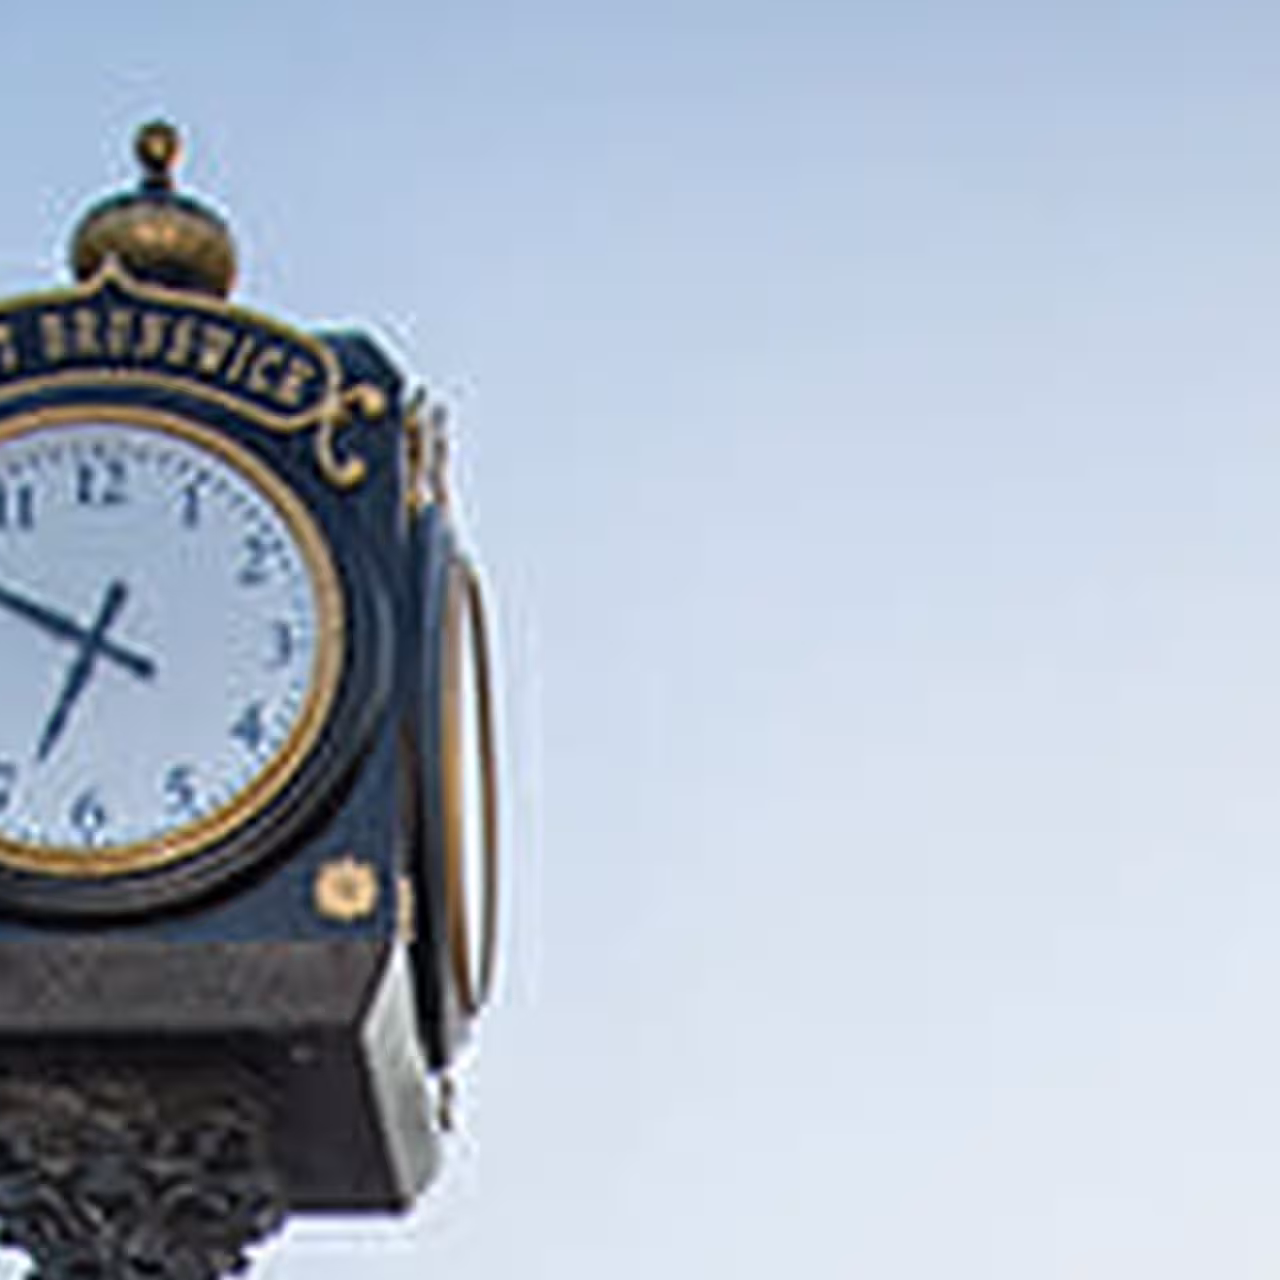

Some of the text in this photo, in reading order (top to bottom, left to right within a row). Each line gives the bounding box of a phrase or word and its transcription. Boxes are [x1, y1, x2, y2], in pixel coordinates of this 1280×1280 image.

[76, 463, 125, 504] 12
[182, 484, 201, 529] 1
[237, 534, 269, 585] 2
[265, 622, 294, 667] 3
[231, 703, 265, 749] 4
[164, 765, 196, 806] 5
[70, 788, 107, 830] 6
